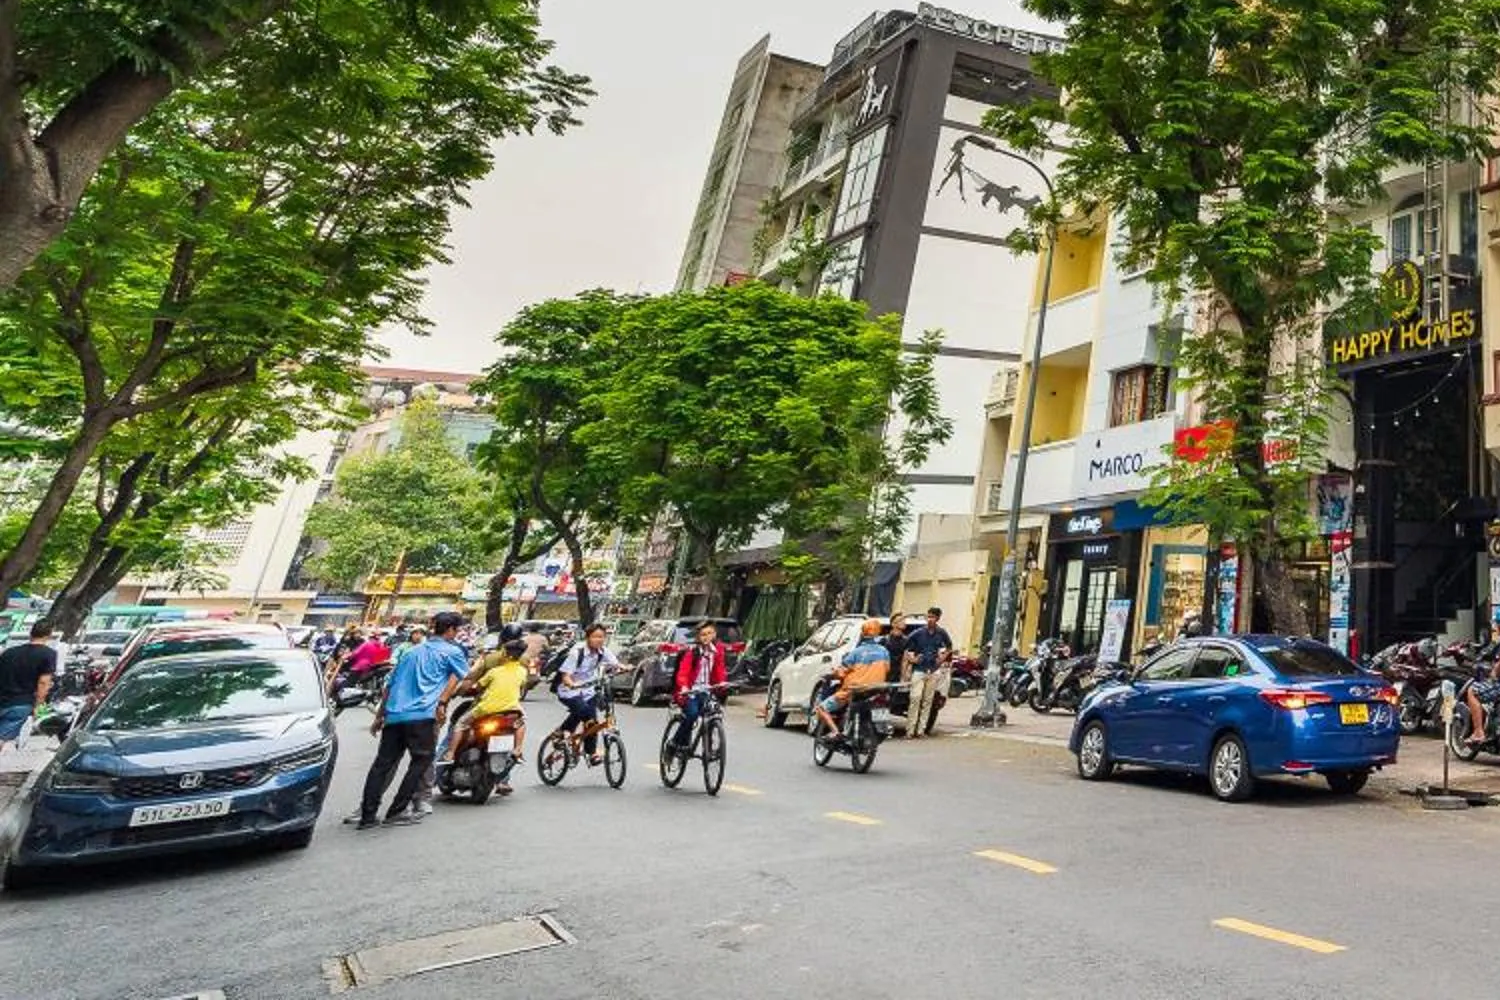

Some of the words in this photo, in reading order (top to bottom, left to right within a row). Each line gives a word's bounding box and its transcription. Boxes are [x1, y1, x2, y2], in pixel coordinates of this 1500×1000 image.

[1333, 327, 1394, 364] HAPPY
[1400, 309, 1476, 350] HOMES
[1089, 453, 1143, 481] MARCO
